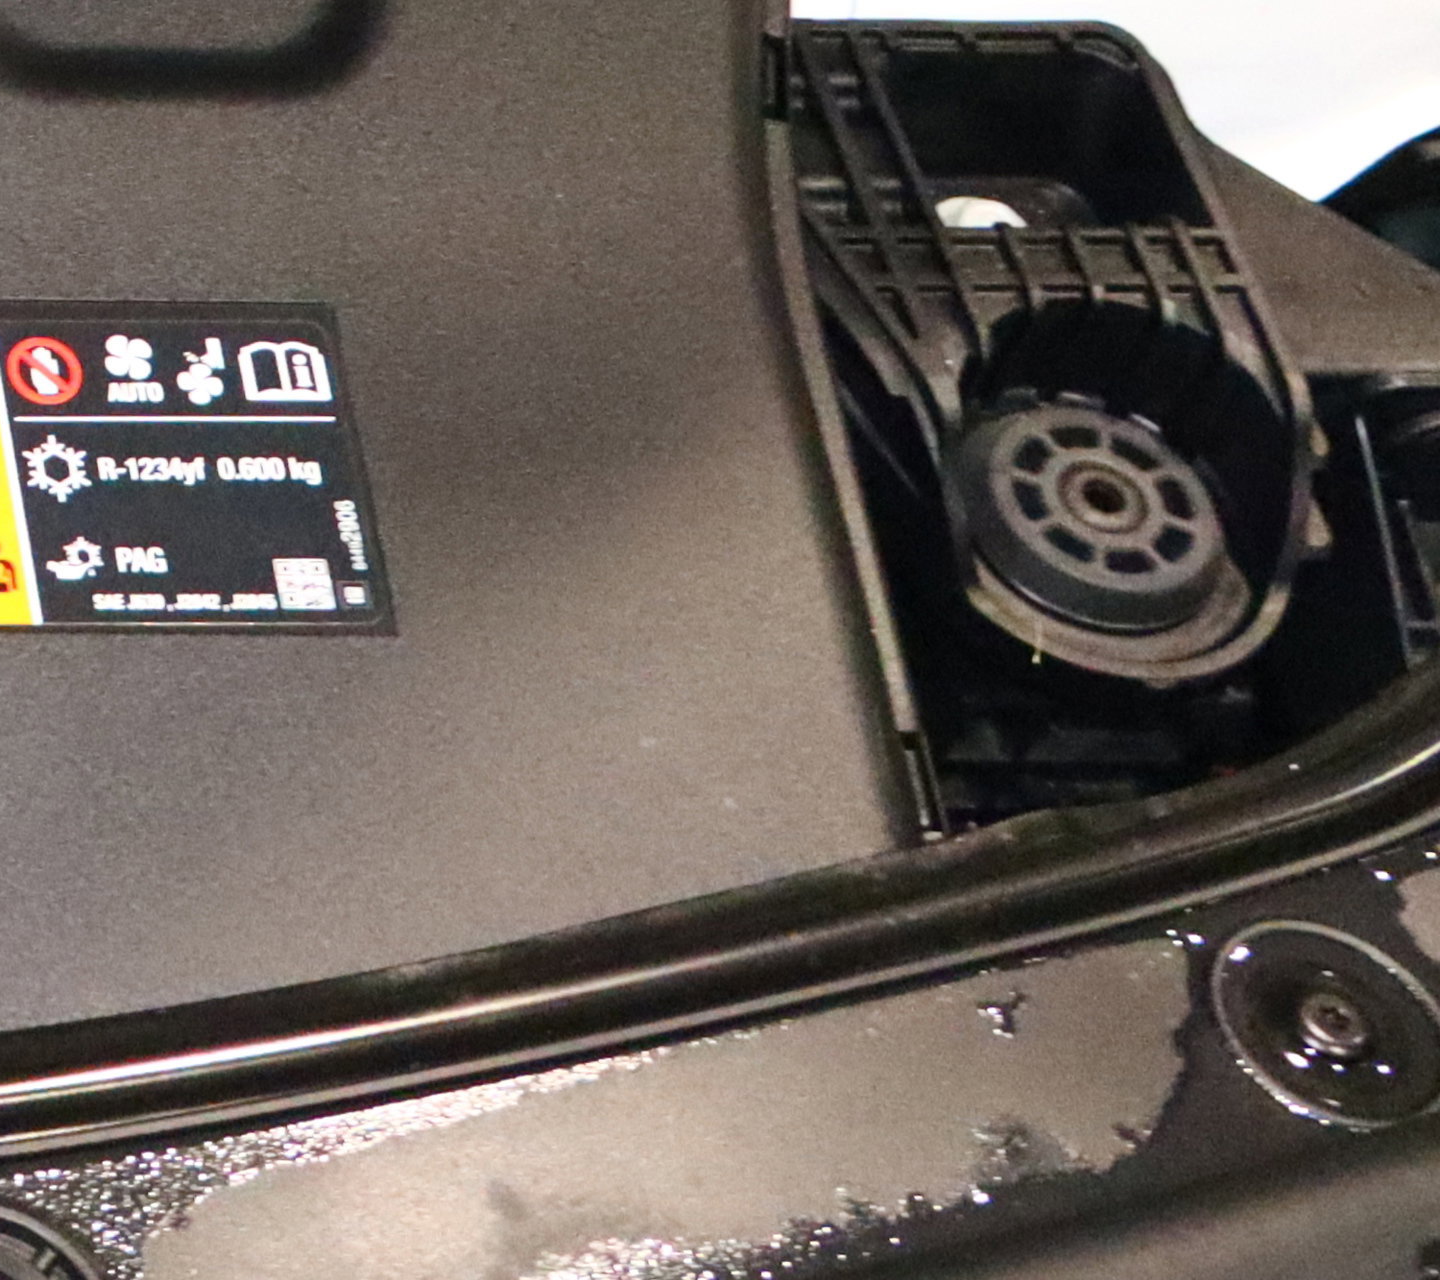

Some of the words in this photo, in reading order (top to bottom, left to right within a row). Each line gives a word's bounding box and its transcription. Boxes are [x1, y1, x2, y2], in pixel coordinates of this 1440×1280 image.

[107, 381, 165, 404] AUTO
[96, 456, 207, 486] R-1234yf
[287, 456, 323, 486] kg
[114, 545, 169, 574] PAG
